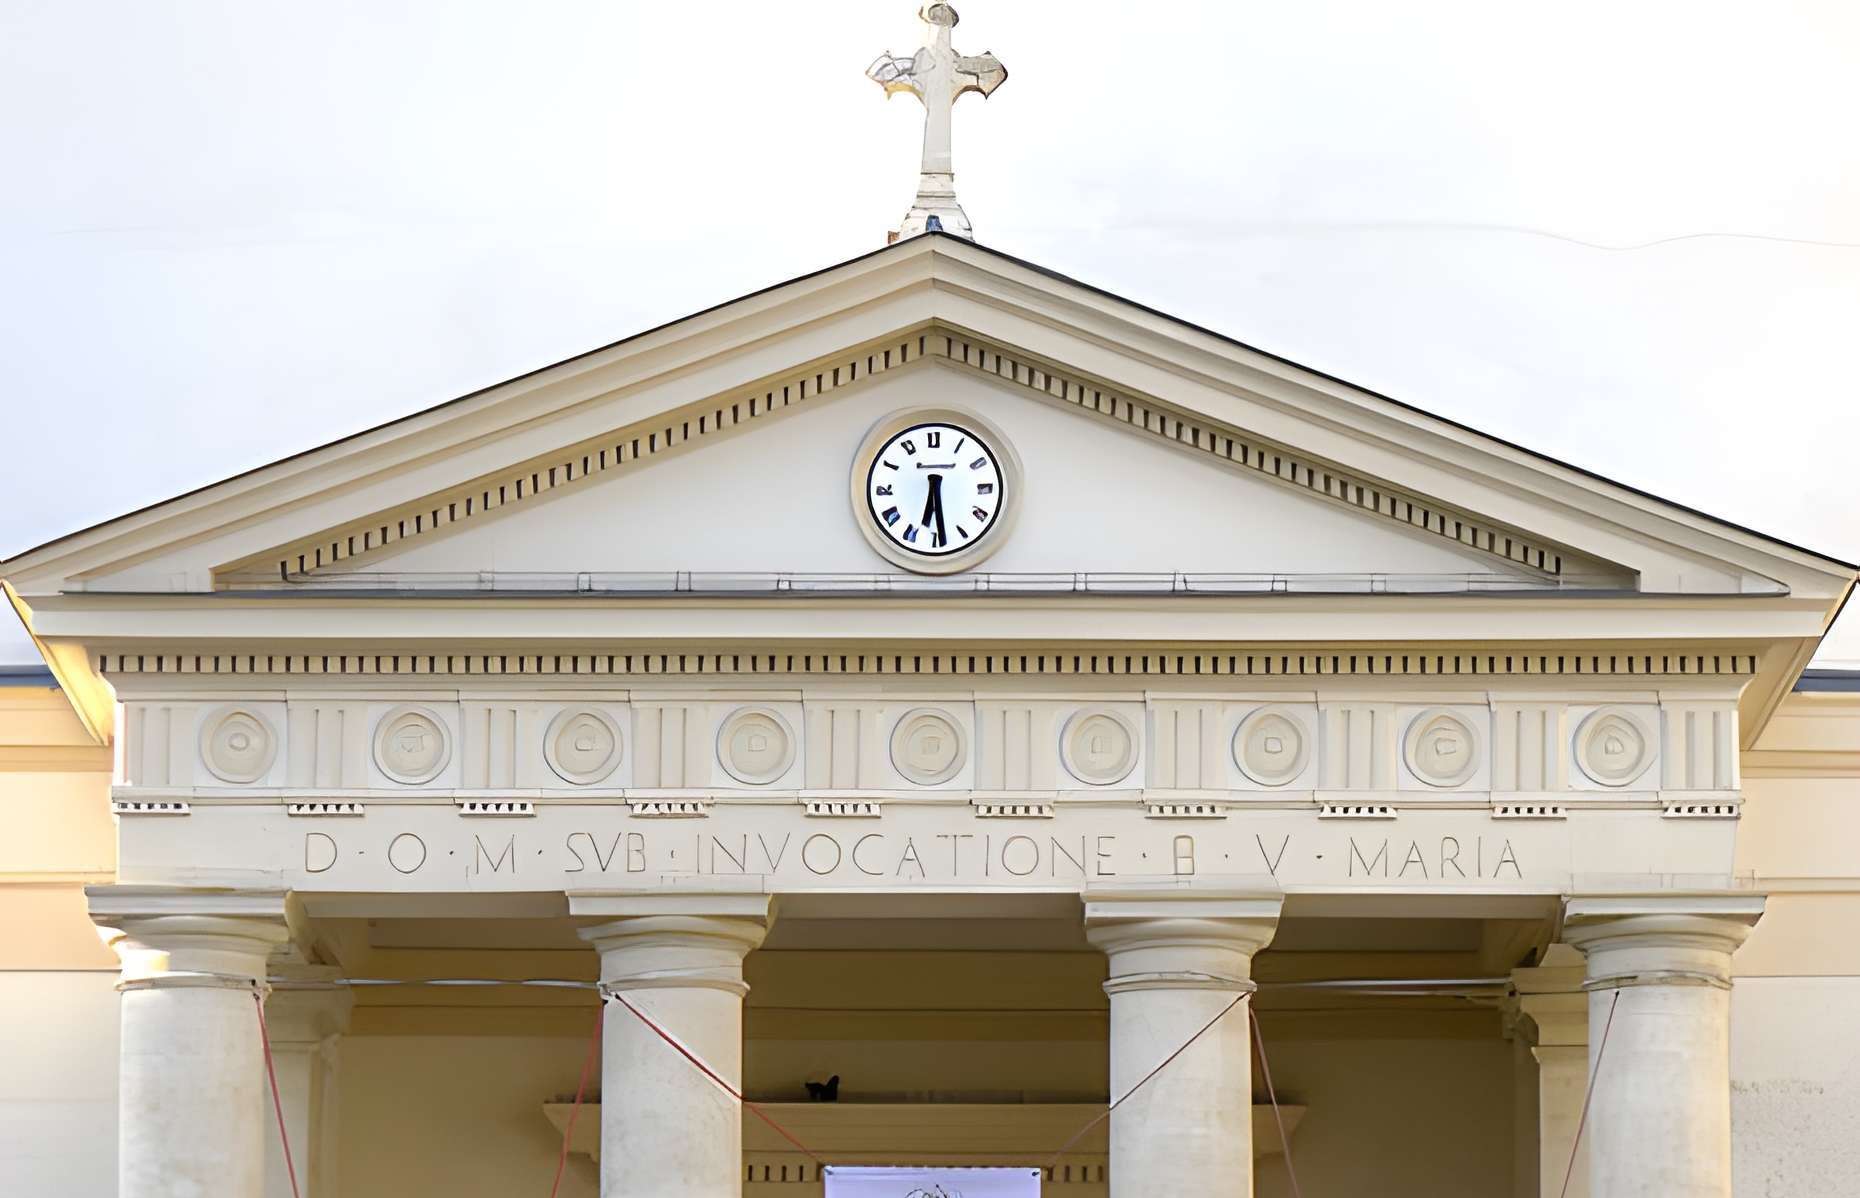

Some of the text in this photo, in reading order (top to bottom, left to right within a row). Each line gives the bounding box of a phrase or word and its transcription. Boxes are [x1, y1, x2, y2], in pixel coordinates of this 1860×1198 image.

[304, 832, 338, 873] D
[388, 832, 427, 874] O
[475, 833, 516, 874] M
[564, 831, 647, 873] SVB
[697, 832, 1117, 877] INVOCATIONE
[1256, 834, 1290, 876] V
[1348, 835, 1523, 879] MARIA
